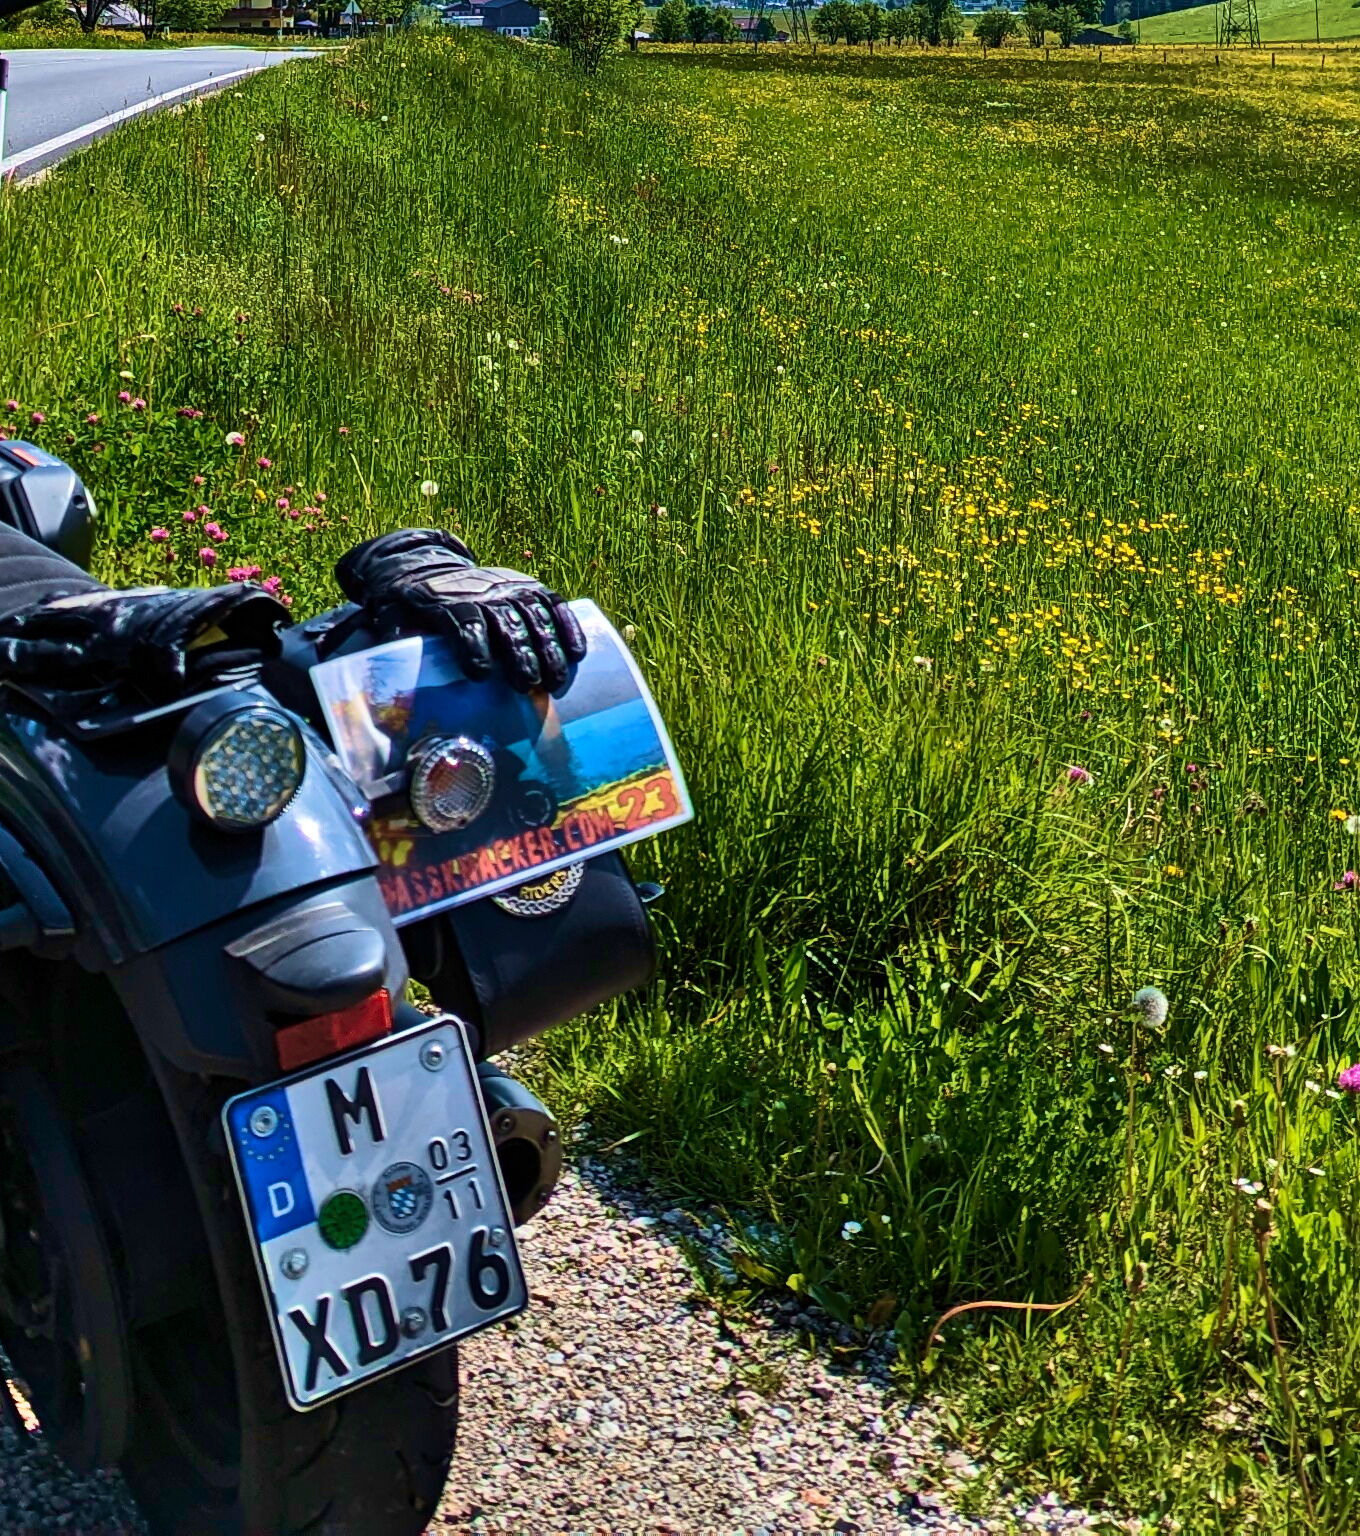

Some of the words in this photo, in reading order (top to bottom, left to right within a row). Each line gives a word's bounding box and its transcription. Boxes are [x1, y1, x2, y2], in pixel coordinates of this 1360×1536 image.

[617, 777, 678, 831] 23
[518, 870, 568, 900] RIDERS
[324, 1065, 387, 1156] M
[427, 1128, 473, 1172] 03
[267, 1181, 296, 1219] D
[442, 1176, 486, 1220] 11
